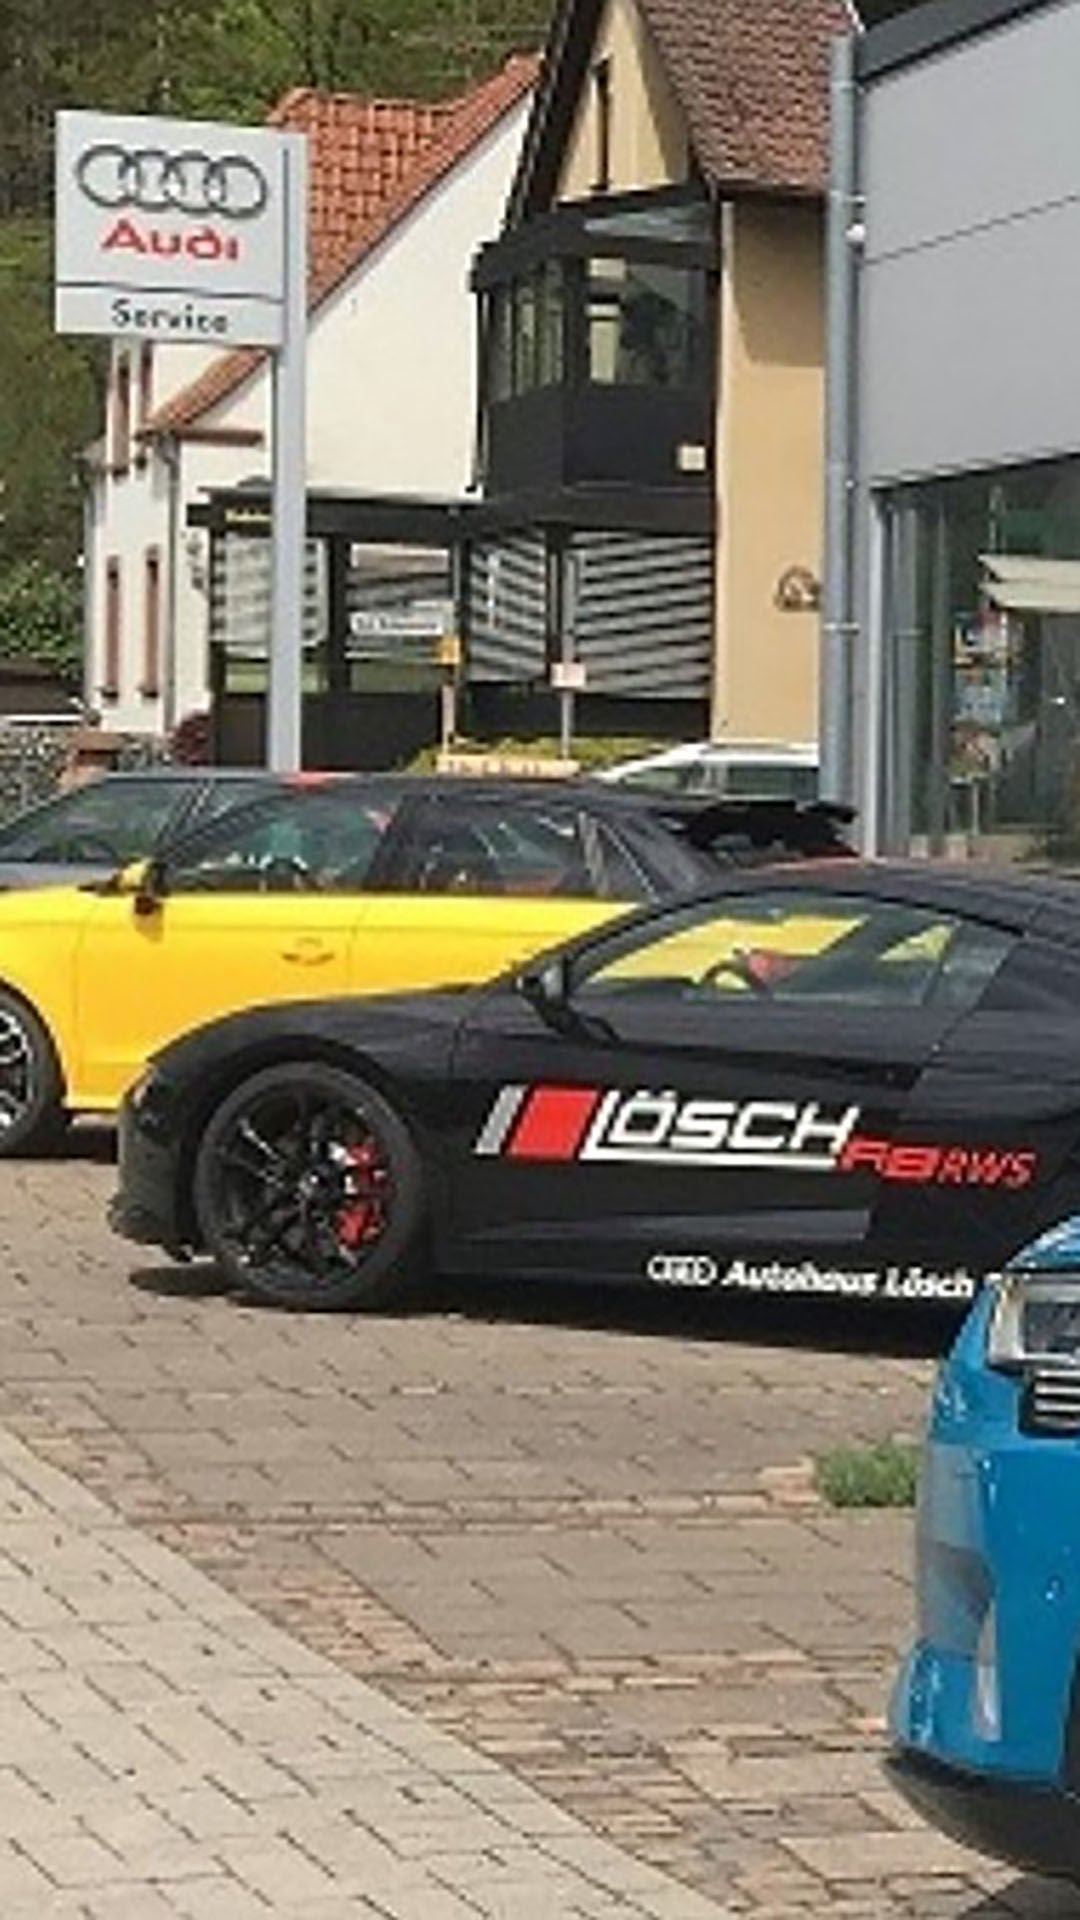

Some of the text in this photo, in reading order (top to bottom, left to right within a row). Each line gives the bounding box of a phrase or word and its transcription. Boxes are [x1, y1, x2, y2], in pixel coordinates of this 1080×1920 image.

[103, 218, 239, 261] Audi
[111, 299, 229, 334] Service
[578, 1089, 1036, 1188] LÖSCH R8 RWS
[721, 1261, 878, 1295] Autohaus
[885, 1267, 975, 1297] Lösch
